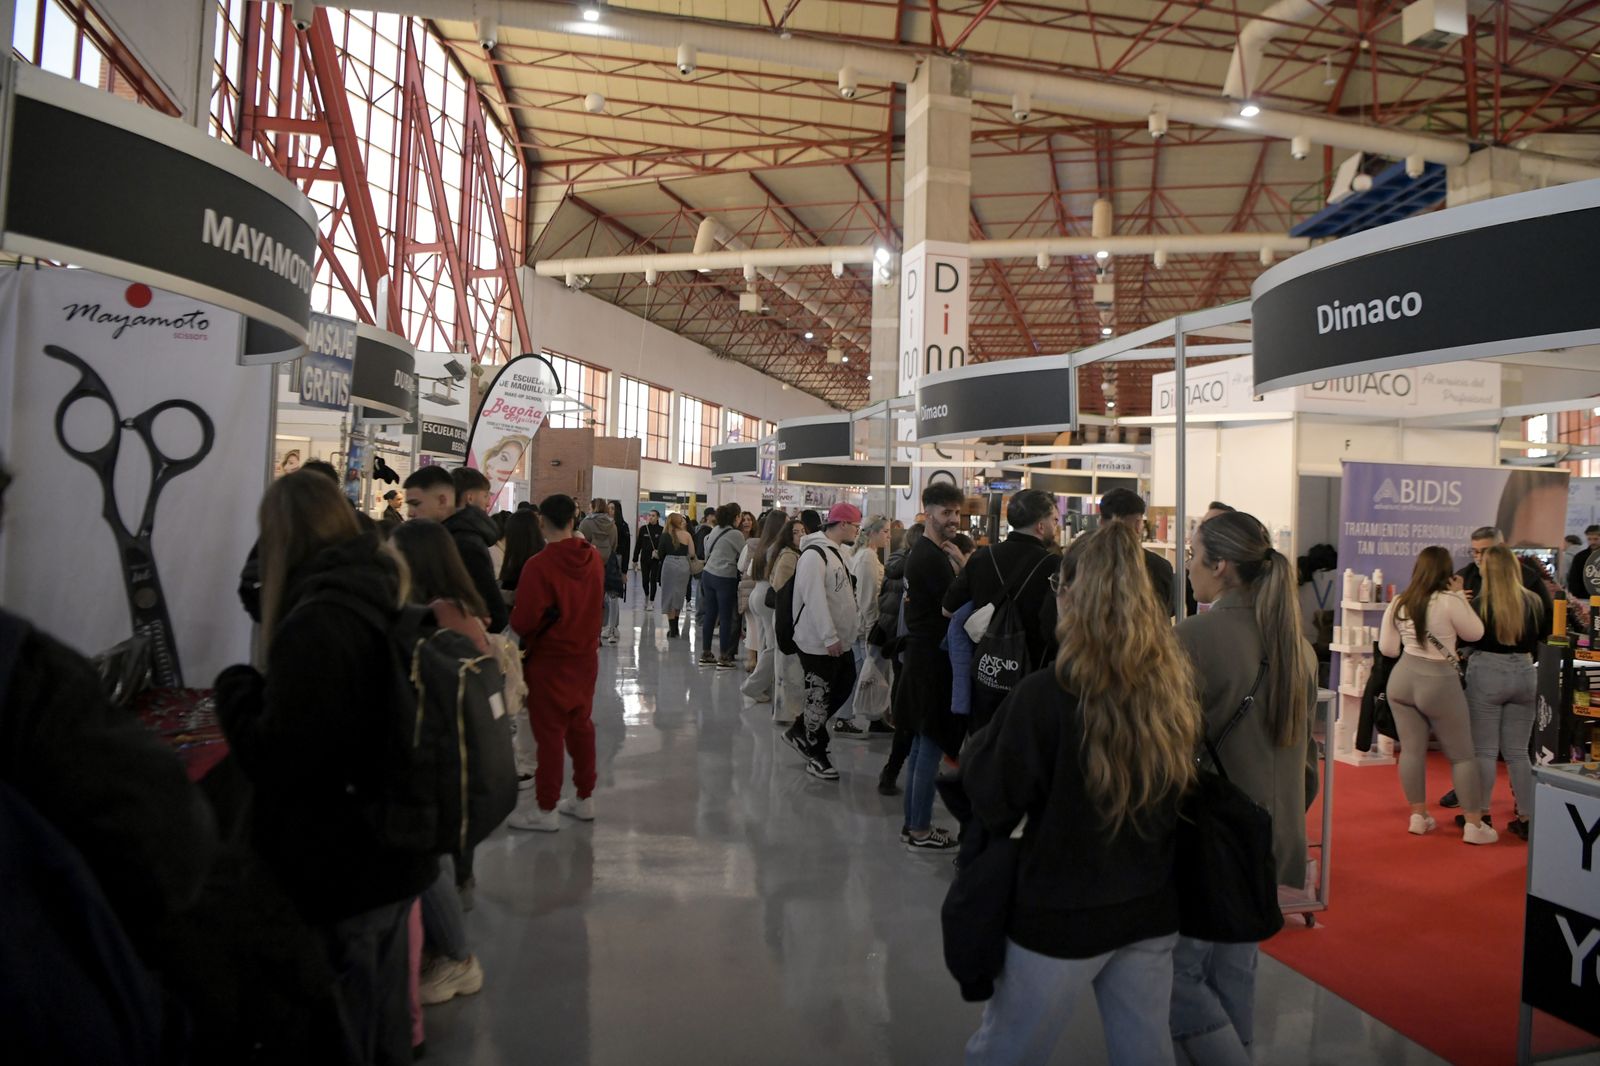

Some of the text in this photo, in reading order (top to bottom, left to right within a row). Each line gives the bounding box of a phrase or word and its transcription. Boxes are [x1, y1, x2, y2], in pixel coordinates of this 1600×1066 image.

[202, 208, 311, 295] MAYAMOTO
[62, 302, 210, 340] Mayamoto
[1317, 290, 1423, 335] Dimaco
[172, 330, 209, 341] scissors
[302, 365, 350, 407] GRATIS
[482, 397, 544, 423] Begoña
[920, 403, 949, 422] Dimaco
[422, 422, 454, 438] ESCUELA
[1344, 439, 1351, 451] F
[1344, 521, 1410, 538] TRATAMIENTOS
[1357, 540, 1375, 555] TAN
[1377, 536, 1410, 556] ÚNICOS
